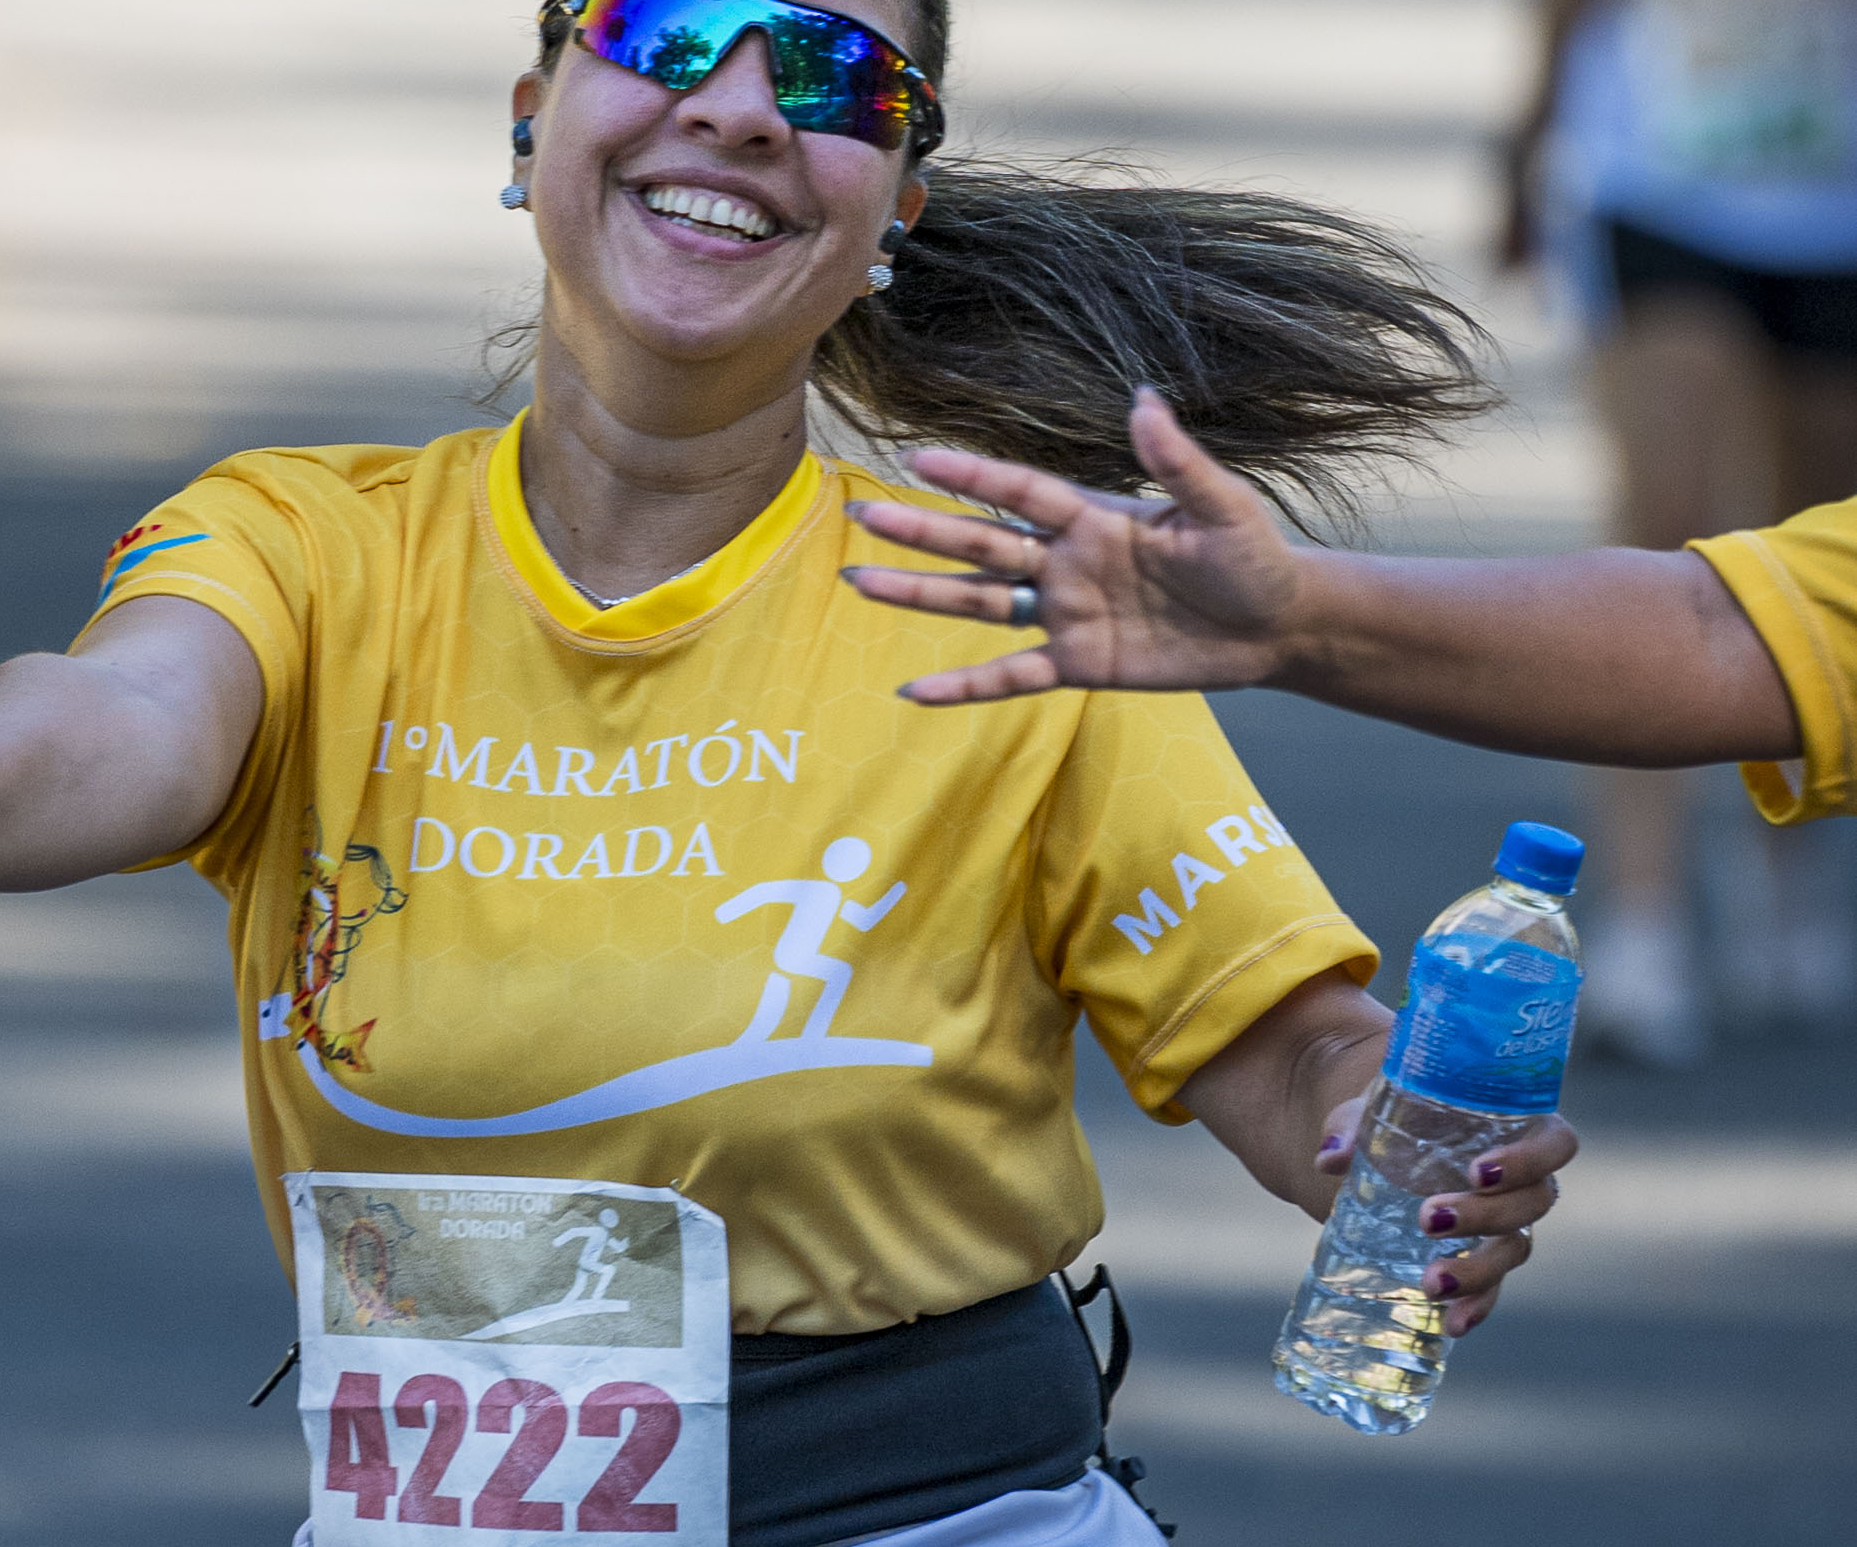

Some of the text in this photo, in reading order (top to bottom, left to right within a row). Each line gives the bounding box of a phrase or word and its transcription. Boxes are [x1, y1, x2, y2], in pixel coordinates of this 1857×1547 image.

[409, 816, 726, 880] DORADA
[446, 1192, 554, 1214] MARATON
[439, 1218, 526, 1239] DORADA
[324, 1371, 683, 1534] 4222
